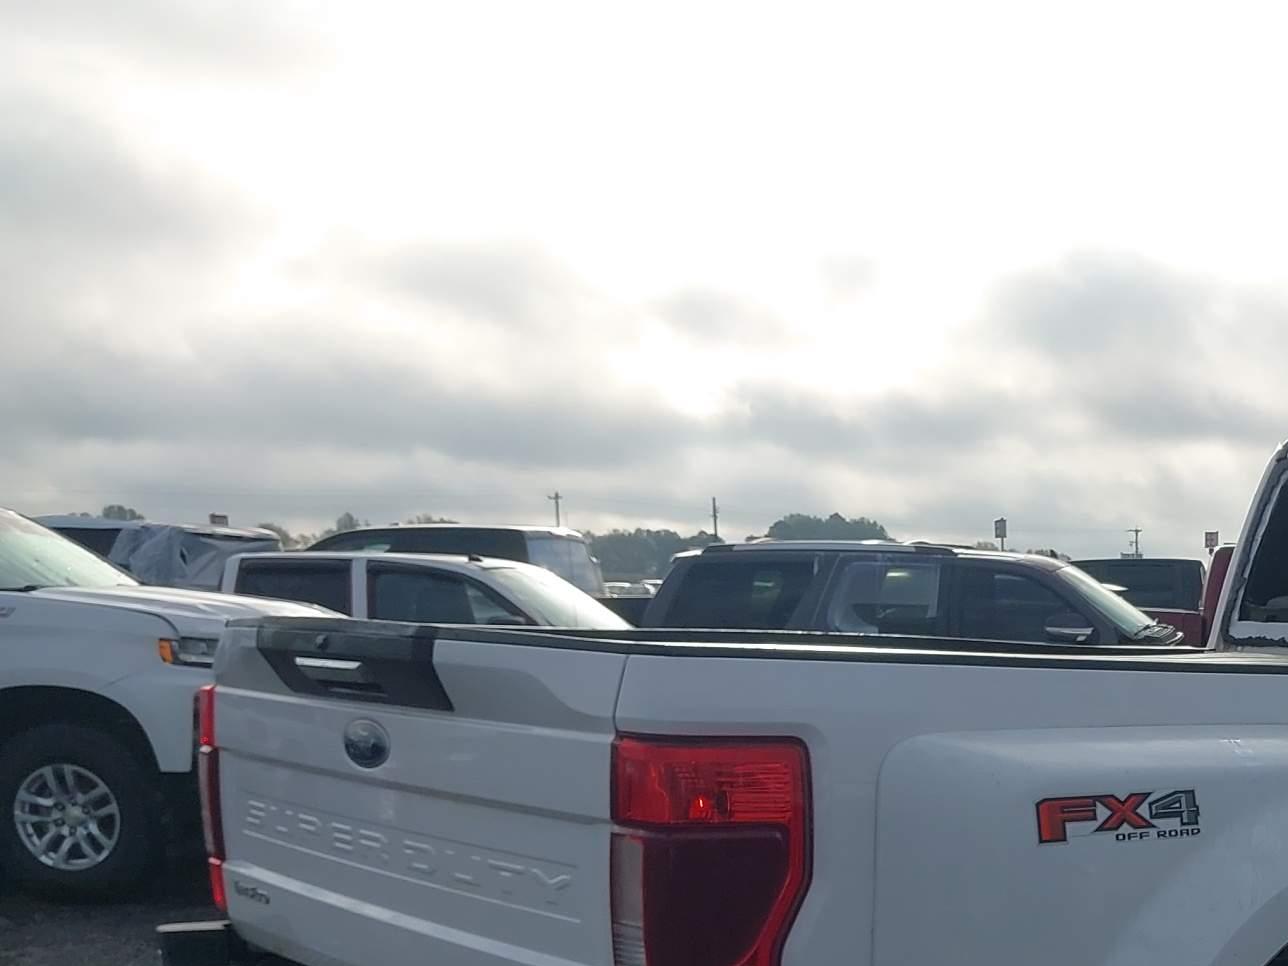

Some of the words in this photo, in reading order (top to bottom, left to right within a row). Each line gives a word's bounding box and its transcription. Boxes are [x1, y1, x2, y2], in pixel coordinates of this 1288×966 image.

[1036, 789, 1200, 844] FX4
[1115, 831, 1150, 842] OFF
[1157, 828, 1201, 839] ROAD
[245, 798, 390, 866] SUPER
[402, 838, 573, 906] DUTY
